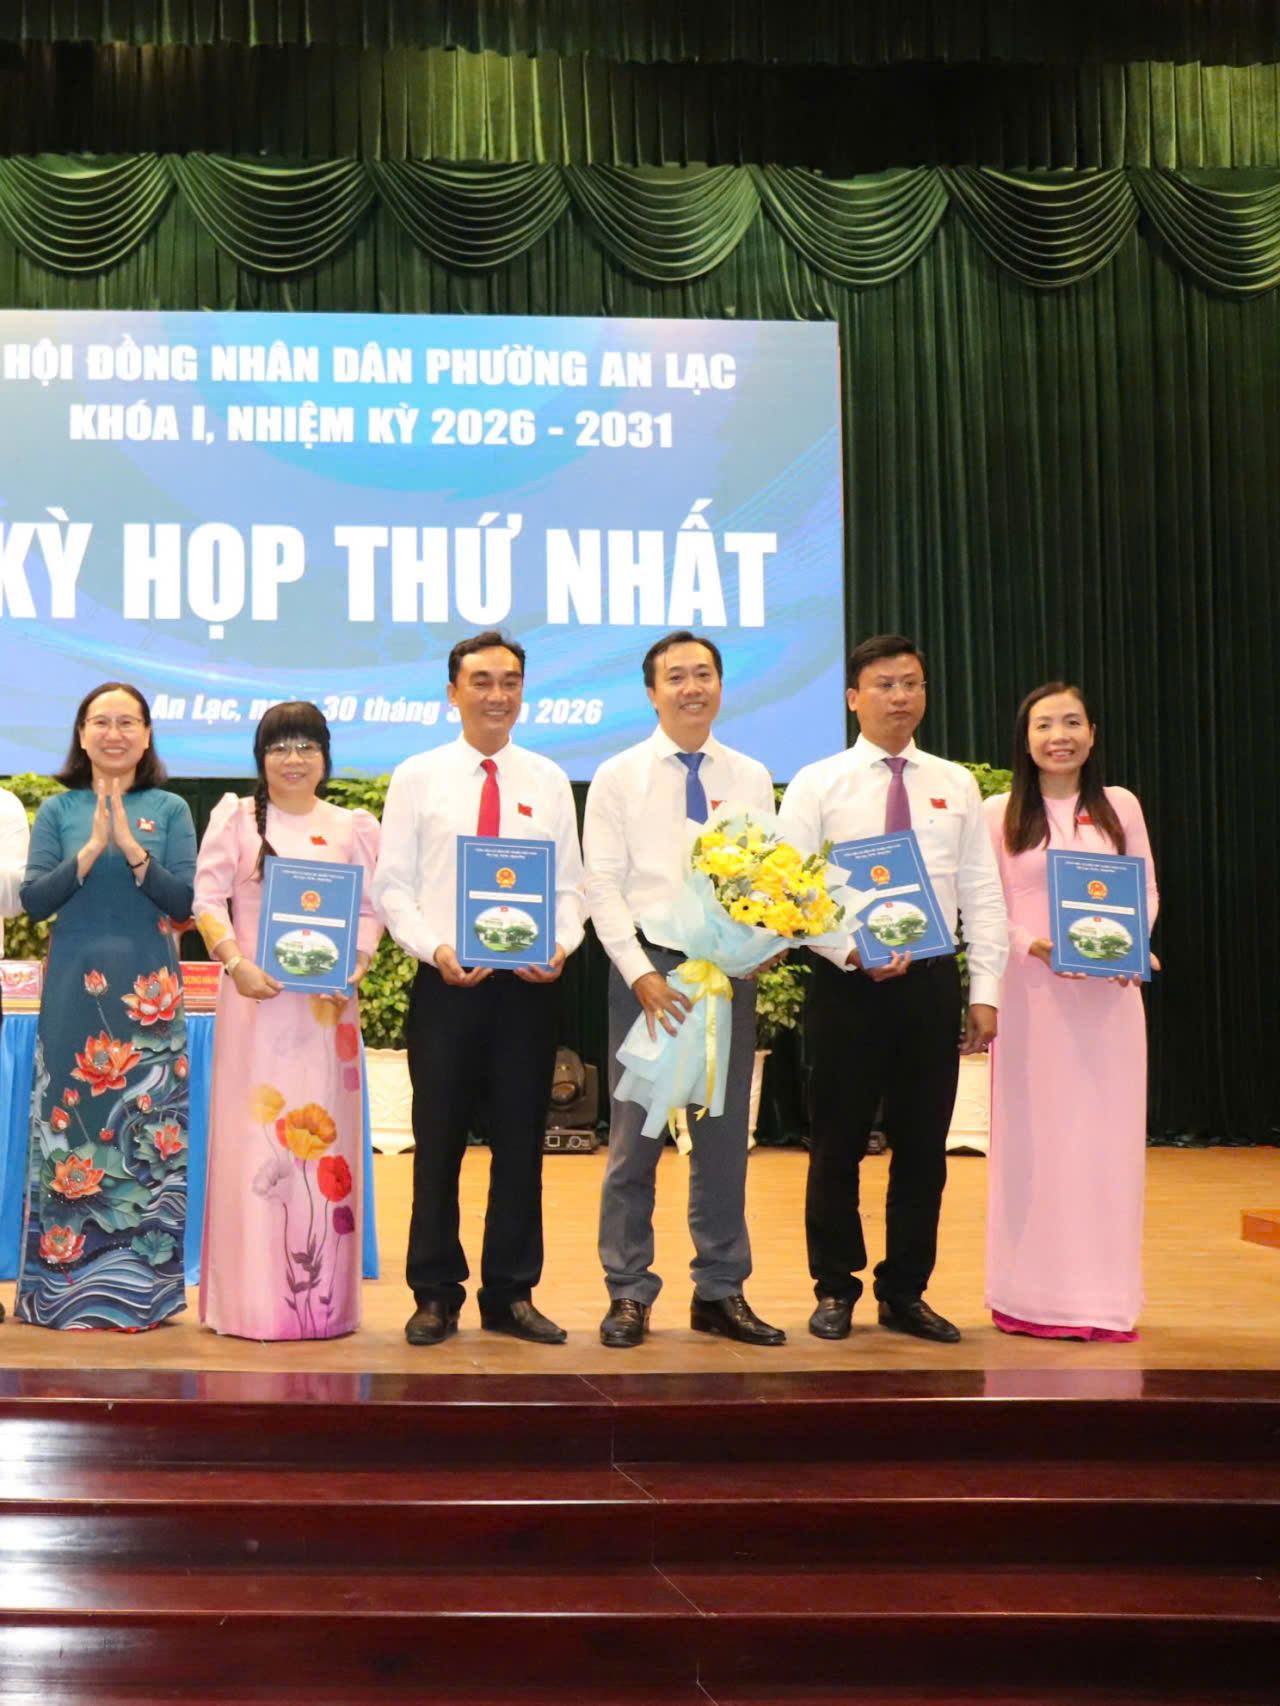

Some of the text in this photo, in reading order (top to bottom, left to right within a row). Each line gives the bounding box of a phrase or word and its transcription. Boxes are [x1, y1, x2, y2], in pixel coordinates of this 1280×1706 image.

[3, 333, 737, 396] HỘI ĐỒNG NHÂN DÂN PHƯỜNG AN LẠC
[69, 399, 673, 449] KHÓA I, NHIỆM KỲ 2026 - 2031
[123, 522, 305, 640] HỌP
[334, 512, 523, 625] THỨ
[546, 497, 778, 628] NHẤT
[150, 694, 186, 720] An
[192, 694, 241, 725] Lạc,
[322, 695, 357, 722] 30
[363, 694, 441, 726] tháng
[535, 699, 603, 725] 2026
